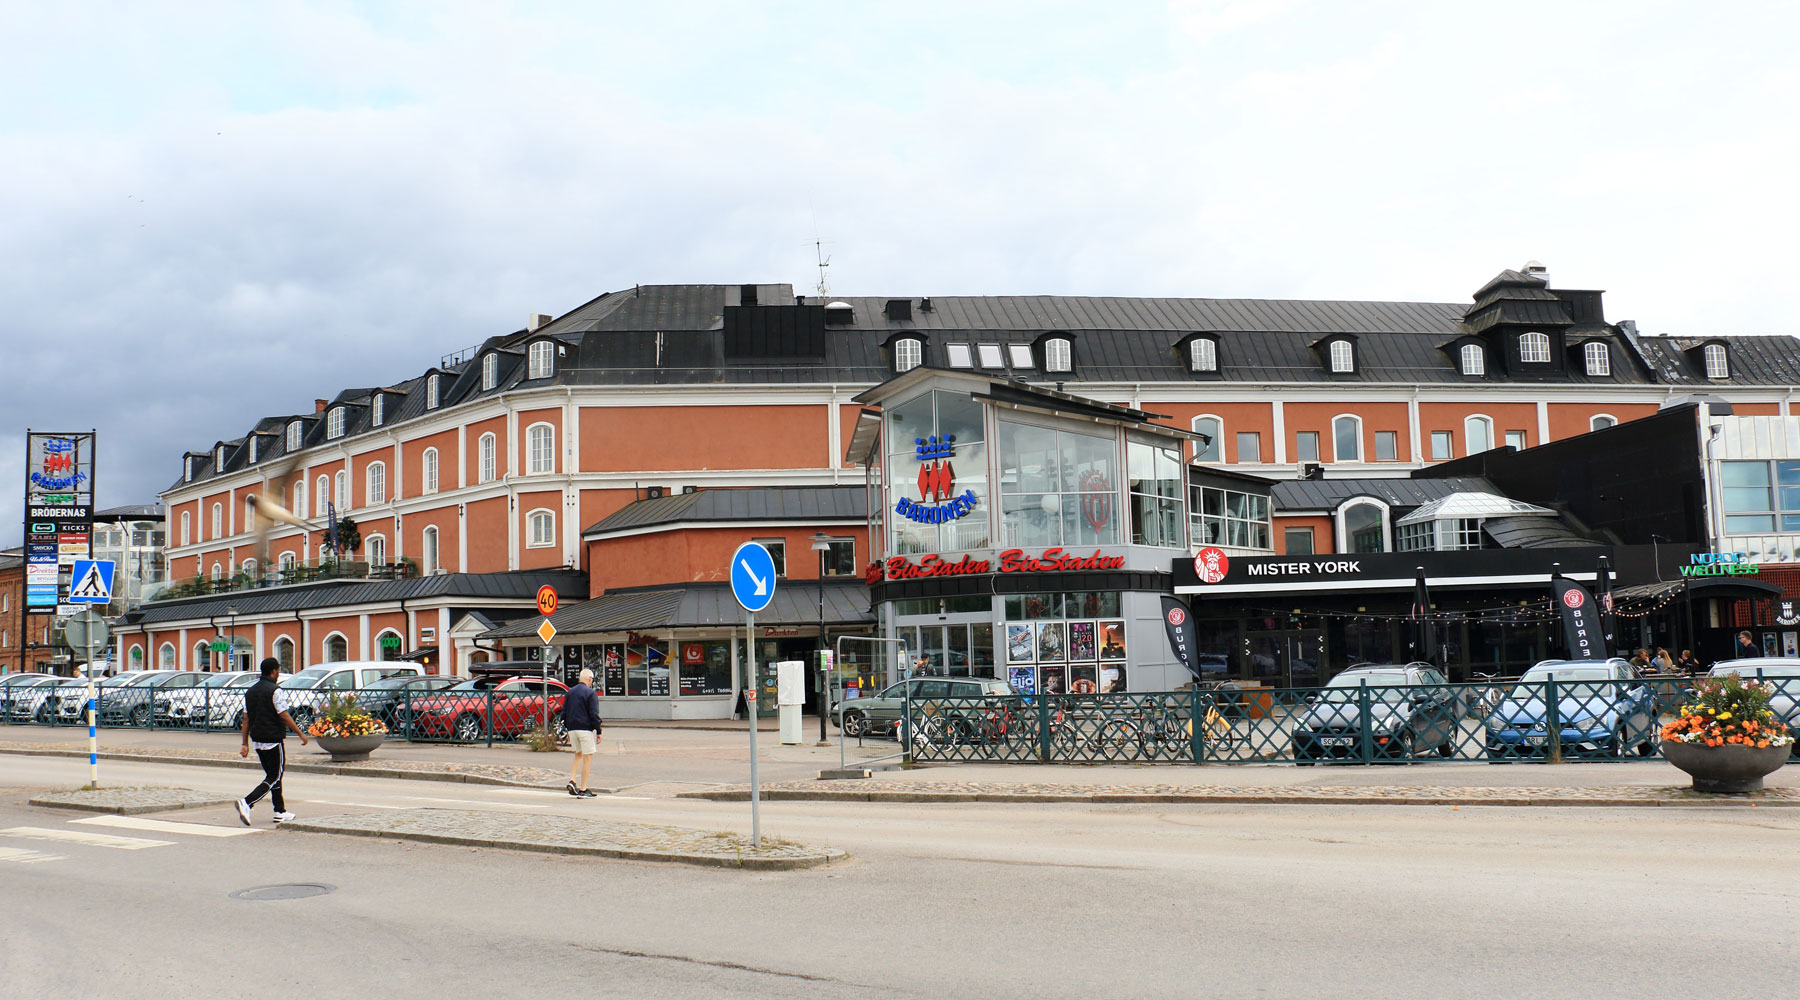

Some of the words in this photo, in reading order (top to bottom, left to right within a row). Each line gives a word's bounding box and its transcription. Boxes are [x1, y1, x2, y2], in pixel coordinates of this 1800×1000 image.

[31, 472, 87, 489] BARONEN
[31, 507, 86, 517] BRÖDERNAS
[895, 489, 977, 524] BARONEN
[887, 553, 990, 579] BioStaden
[1000, 548, 1125, 572] BioStaden
[1691, 552, 1746, 565] NORDIC
[1248, 562, 1311, 576] MISTER
[1314, 561, 1361, 574] YORK
[1680, 563, 1760, 577] WELLNESS
[540, 592, 555, 608] 40
